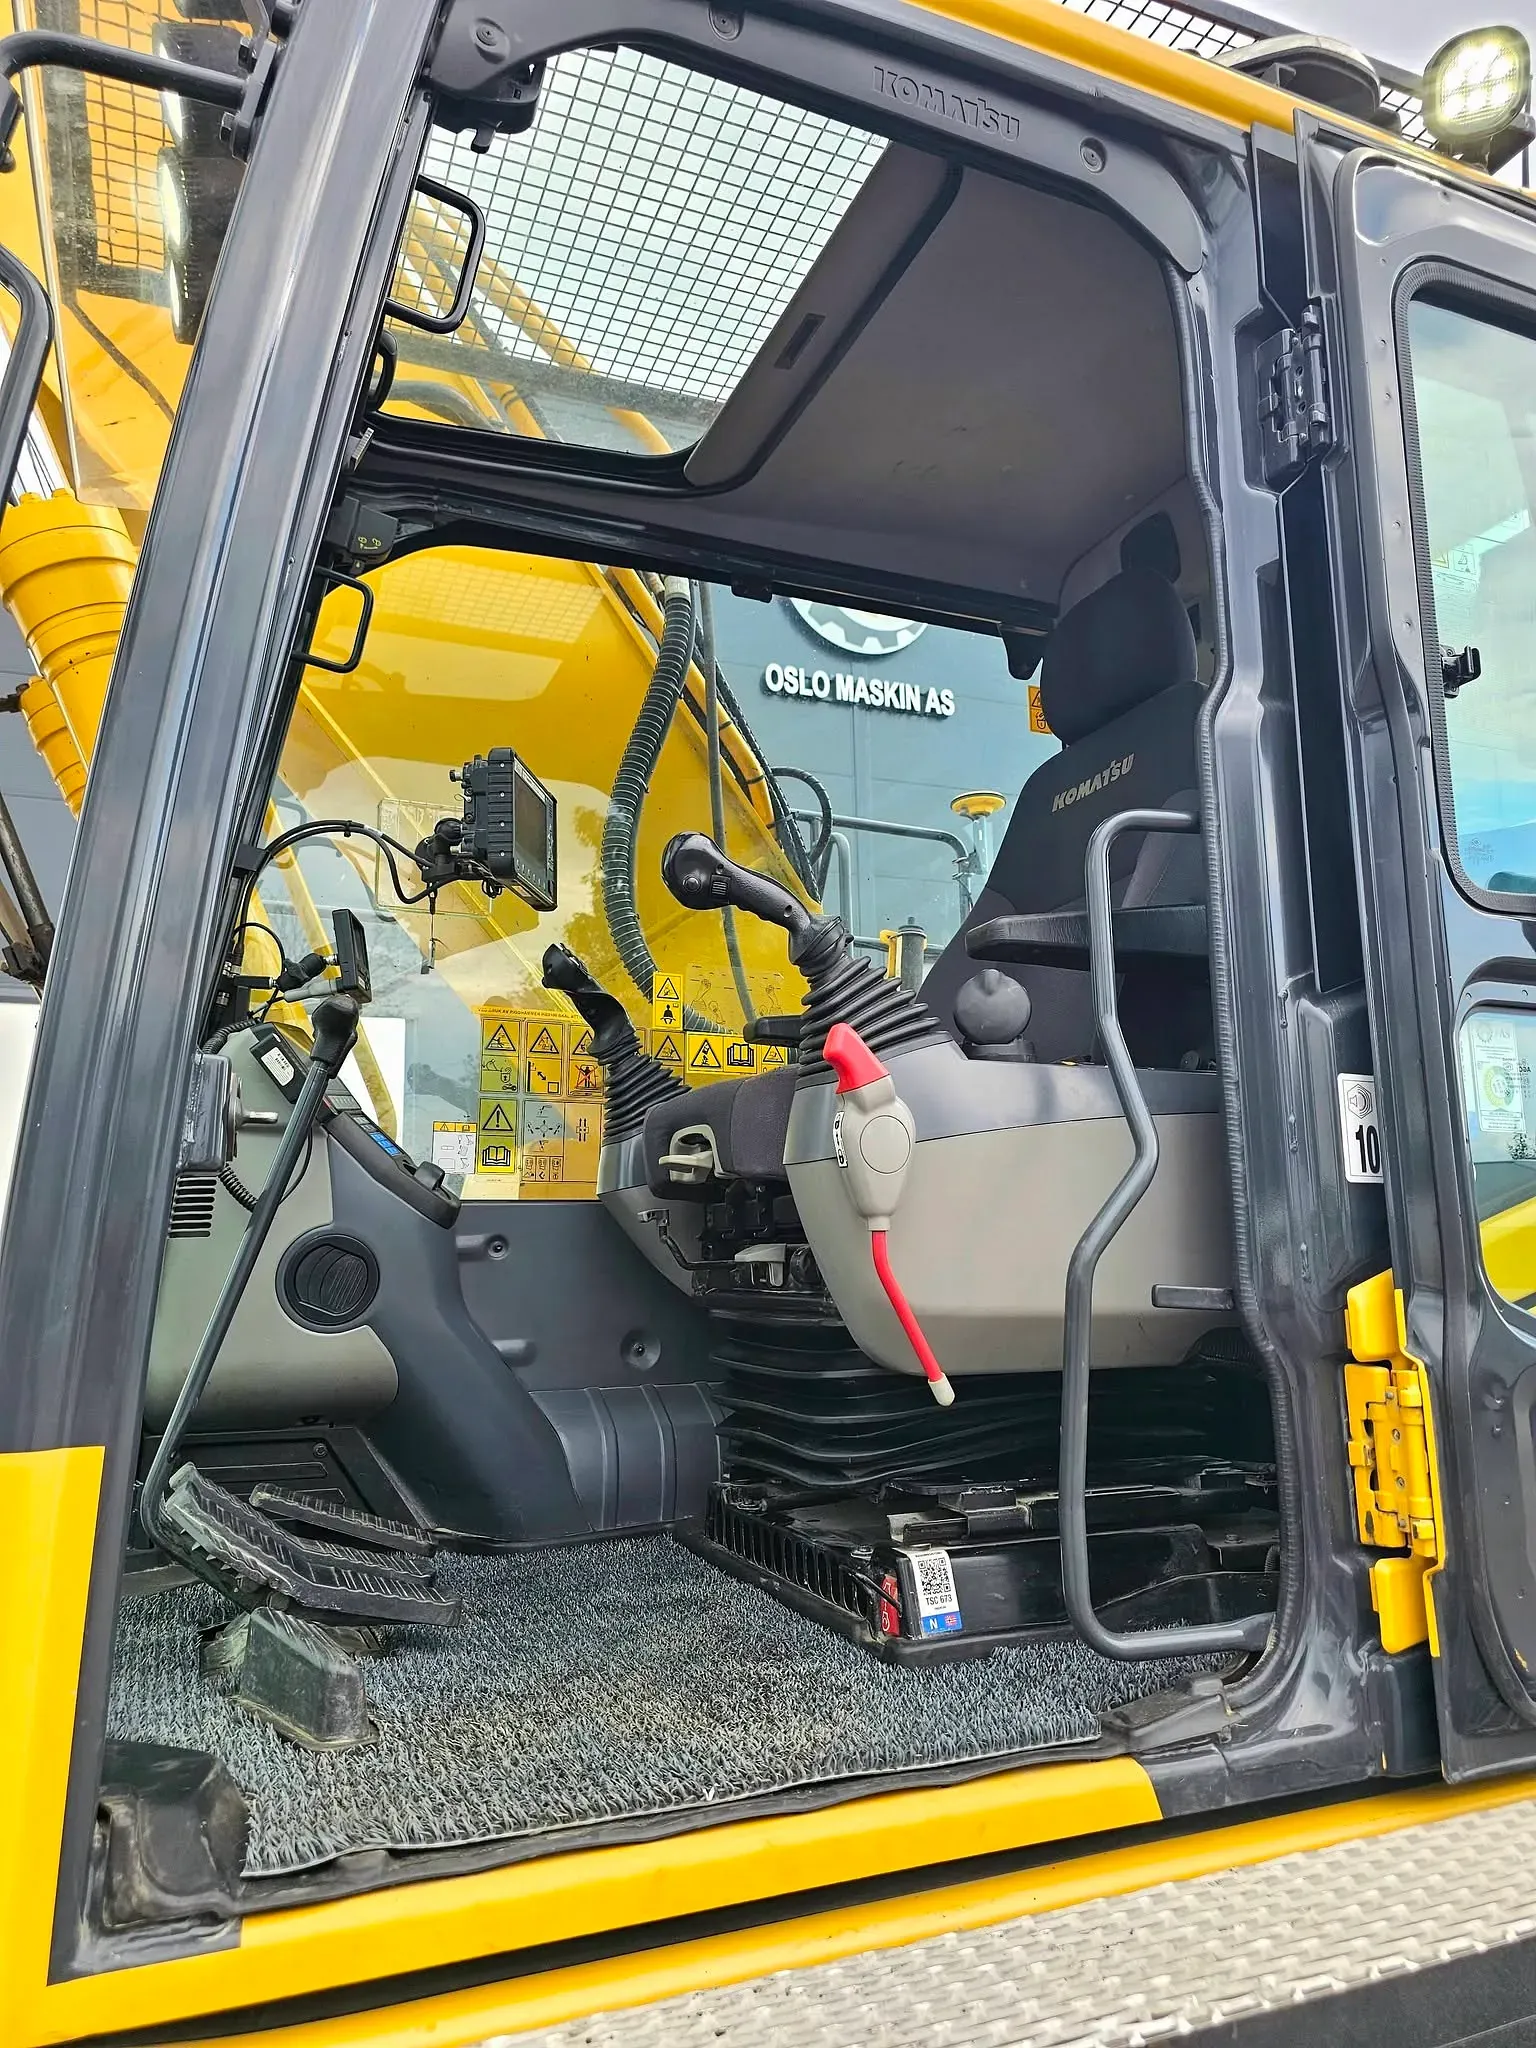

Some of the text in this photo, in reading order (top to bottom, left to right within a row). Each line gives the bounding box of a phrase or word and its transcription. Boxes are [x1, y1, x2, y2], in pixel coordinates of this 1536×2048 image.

[872, 66, 1020, 141] KOMATSU
[765, 662, 956, 716] OSLO MASKIN AS
[1051, 753, 1135, 813] KOMATSU
[925, 1594, 953, 1606] TSC 673
[929, 1617, 938, 1630] N
